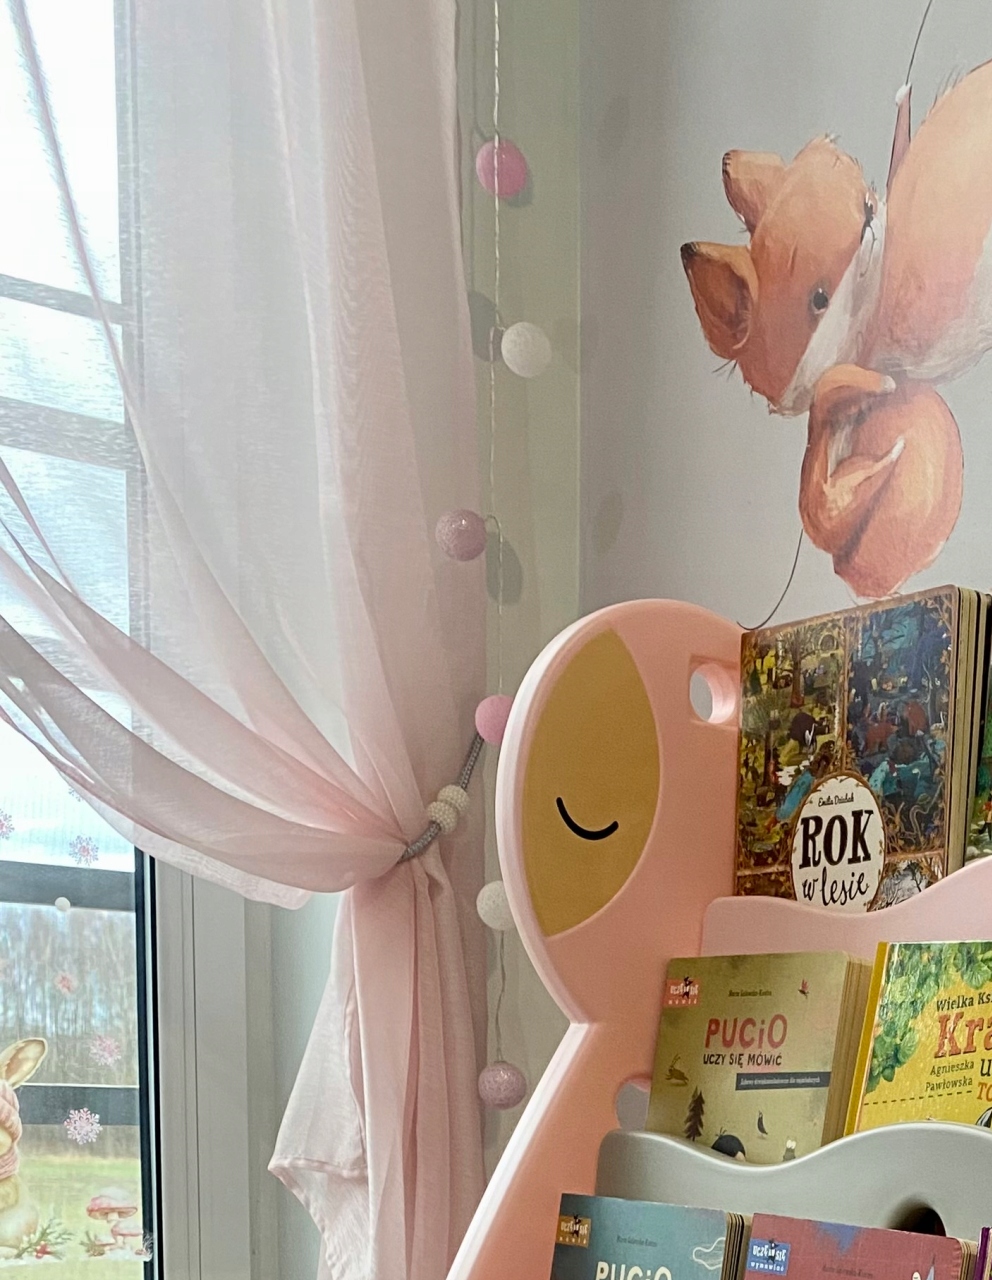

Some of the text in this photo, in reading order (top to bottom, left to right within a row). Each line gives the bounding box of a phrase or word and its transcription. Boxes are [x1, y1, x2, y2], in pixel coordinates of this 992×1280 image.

[799, 809, 874, 869] ROK
[802, 866, 869, 906] w lesie
[936, 995, 974, 1012] Wielka
[703, 1054, 727, 1066] UCZY
[930, 1060, 975, 1077] Agnieszka
[925, 1076, 973, 1092] Pawłowska
